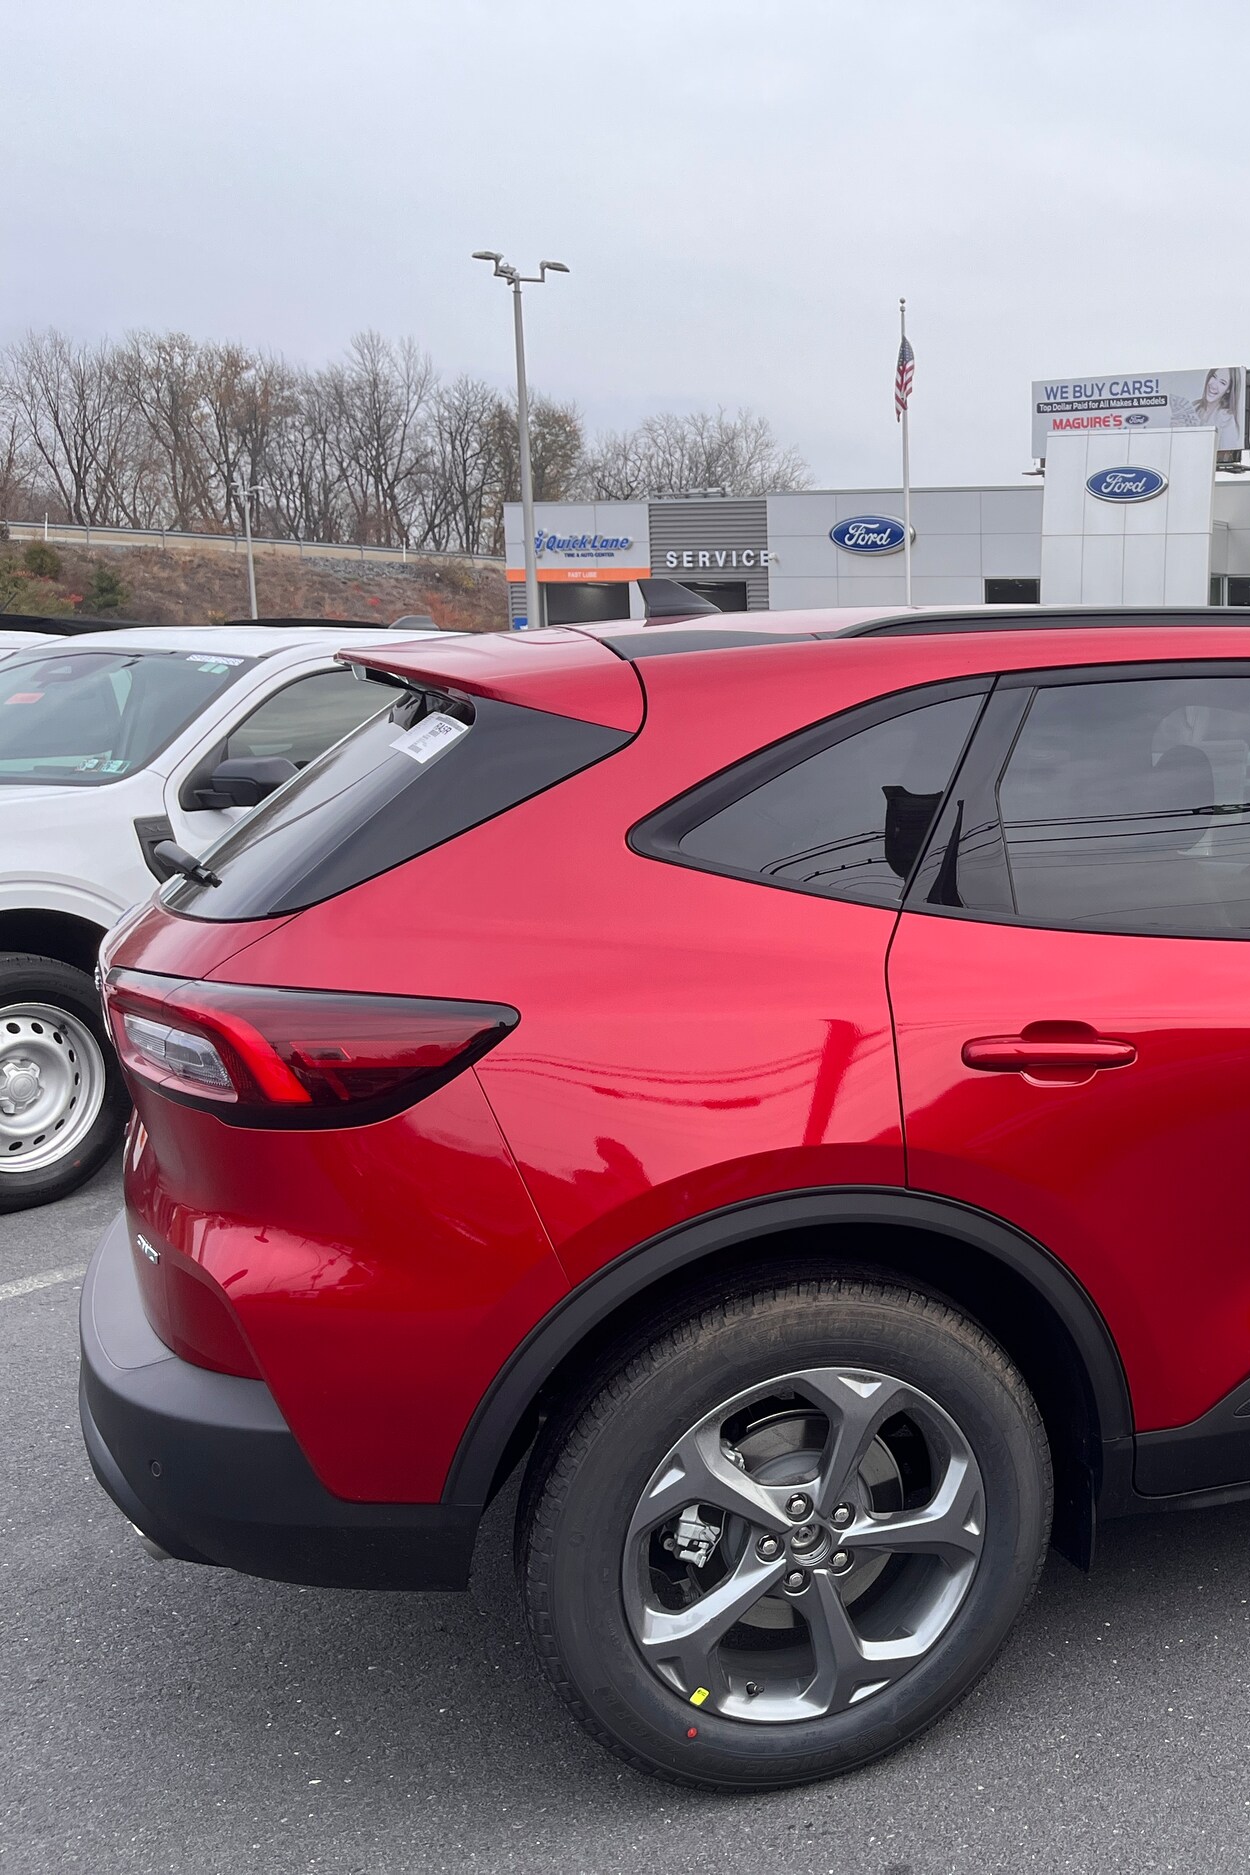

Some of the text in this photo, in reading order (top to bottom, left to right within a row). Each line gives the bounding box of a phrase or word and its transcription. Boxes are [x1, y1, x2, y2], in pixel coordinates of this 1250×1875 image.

[1044, 379, 1159, 401] WE BUY CARS!
[1039, 397, 1166, 413] Top Dollar Paid for All Makes & Models
[1052, 413, 1123, 430] MAGUIRE'S
[1101, 472, 1146, 494] Ford
[545, 534, 630, 551] Quick Lane
[844, 522, 892, 546] Ford
[665, 549, 769, 568] SERVICE
